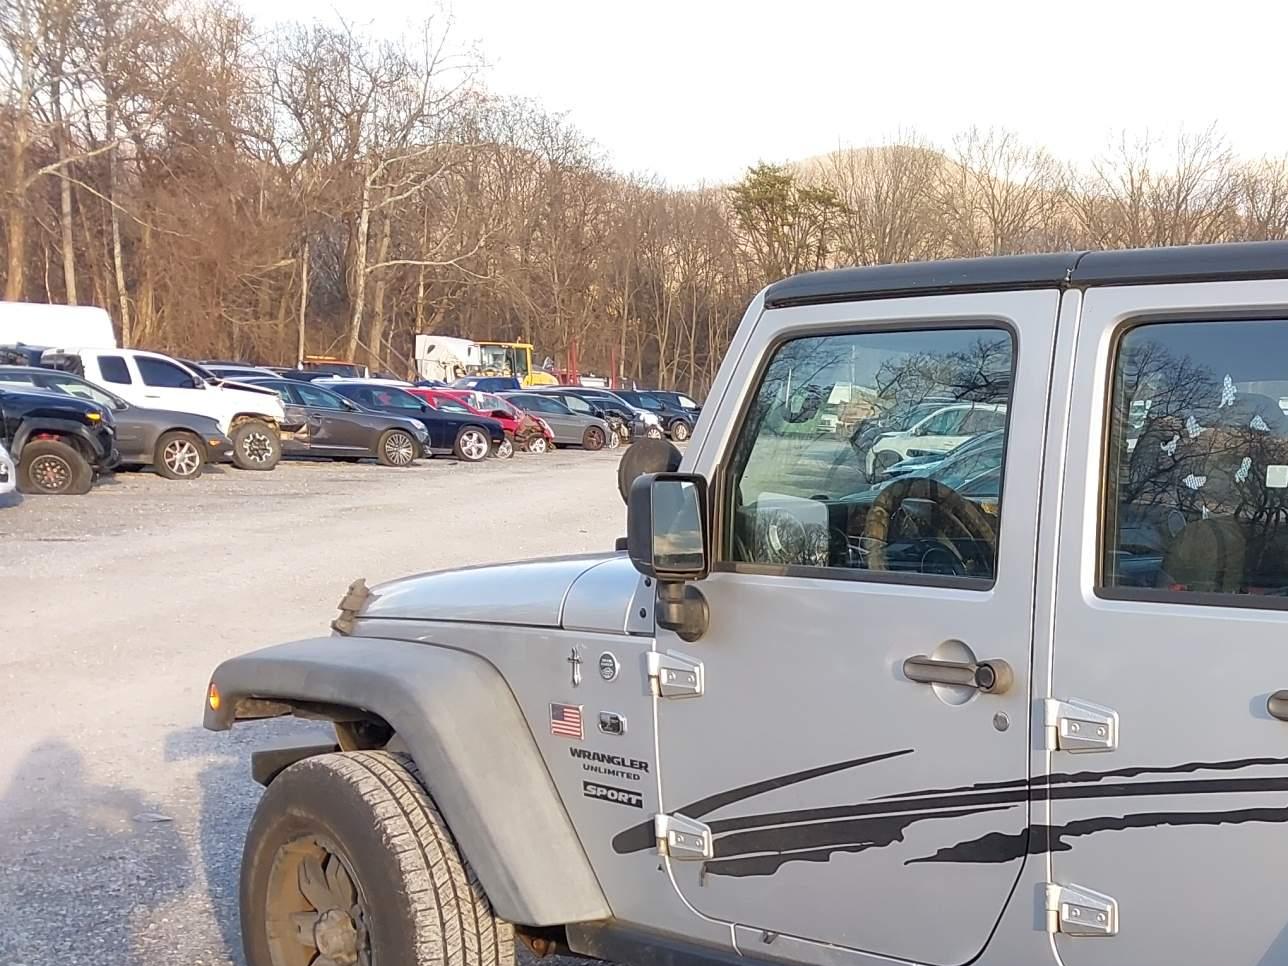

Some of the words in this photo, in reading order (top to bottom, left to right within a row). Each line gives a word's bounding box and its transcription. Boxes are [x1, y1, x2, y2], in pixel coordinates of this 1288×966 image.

[569, 747, 649, 773] WRANGLER
[583, 763, 641, 781] UNLIMITED
[585, 784, 642, 805] SPORT
